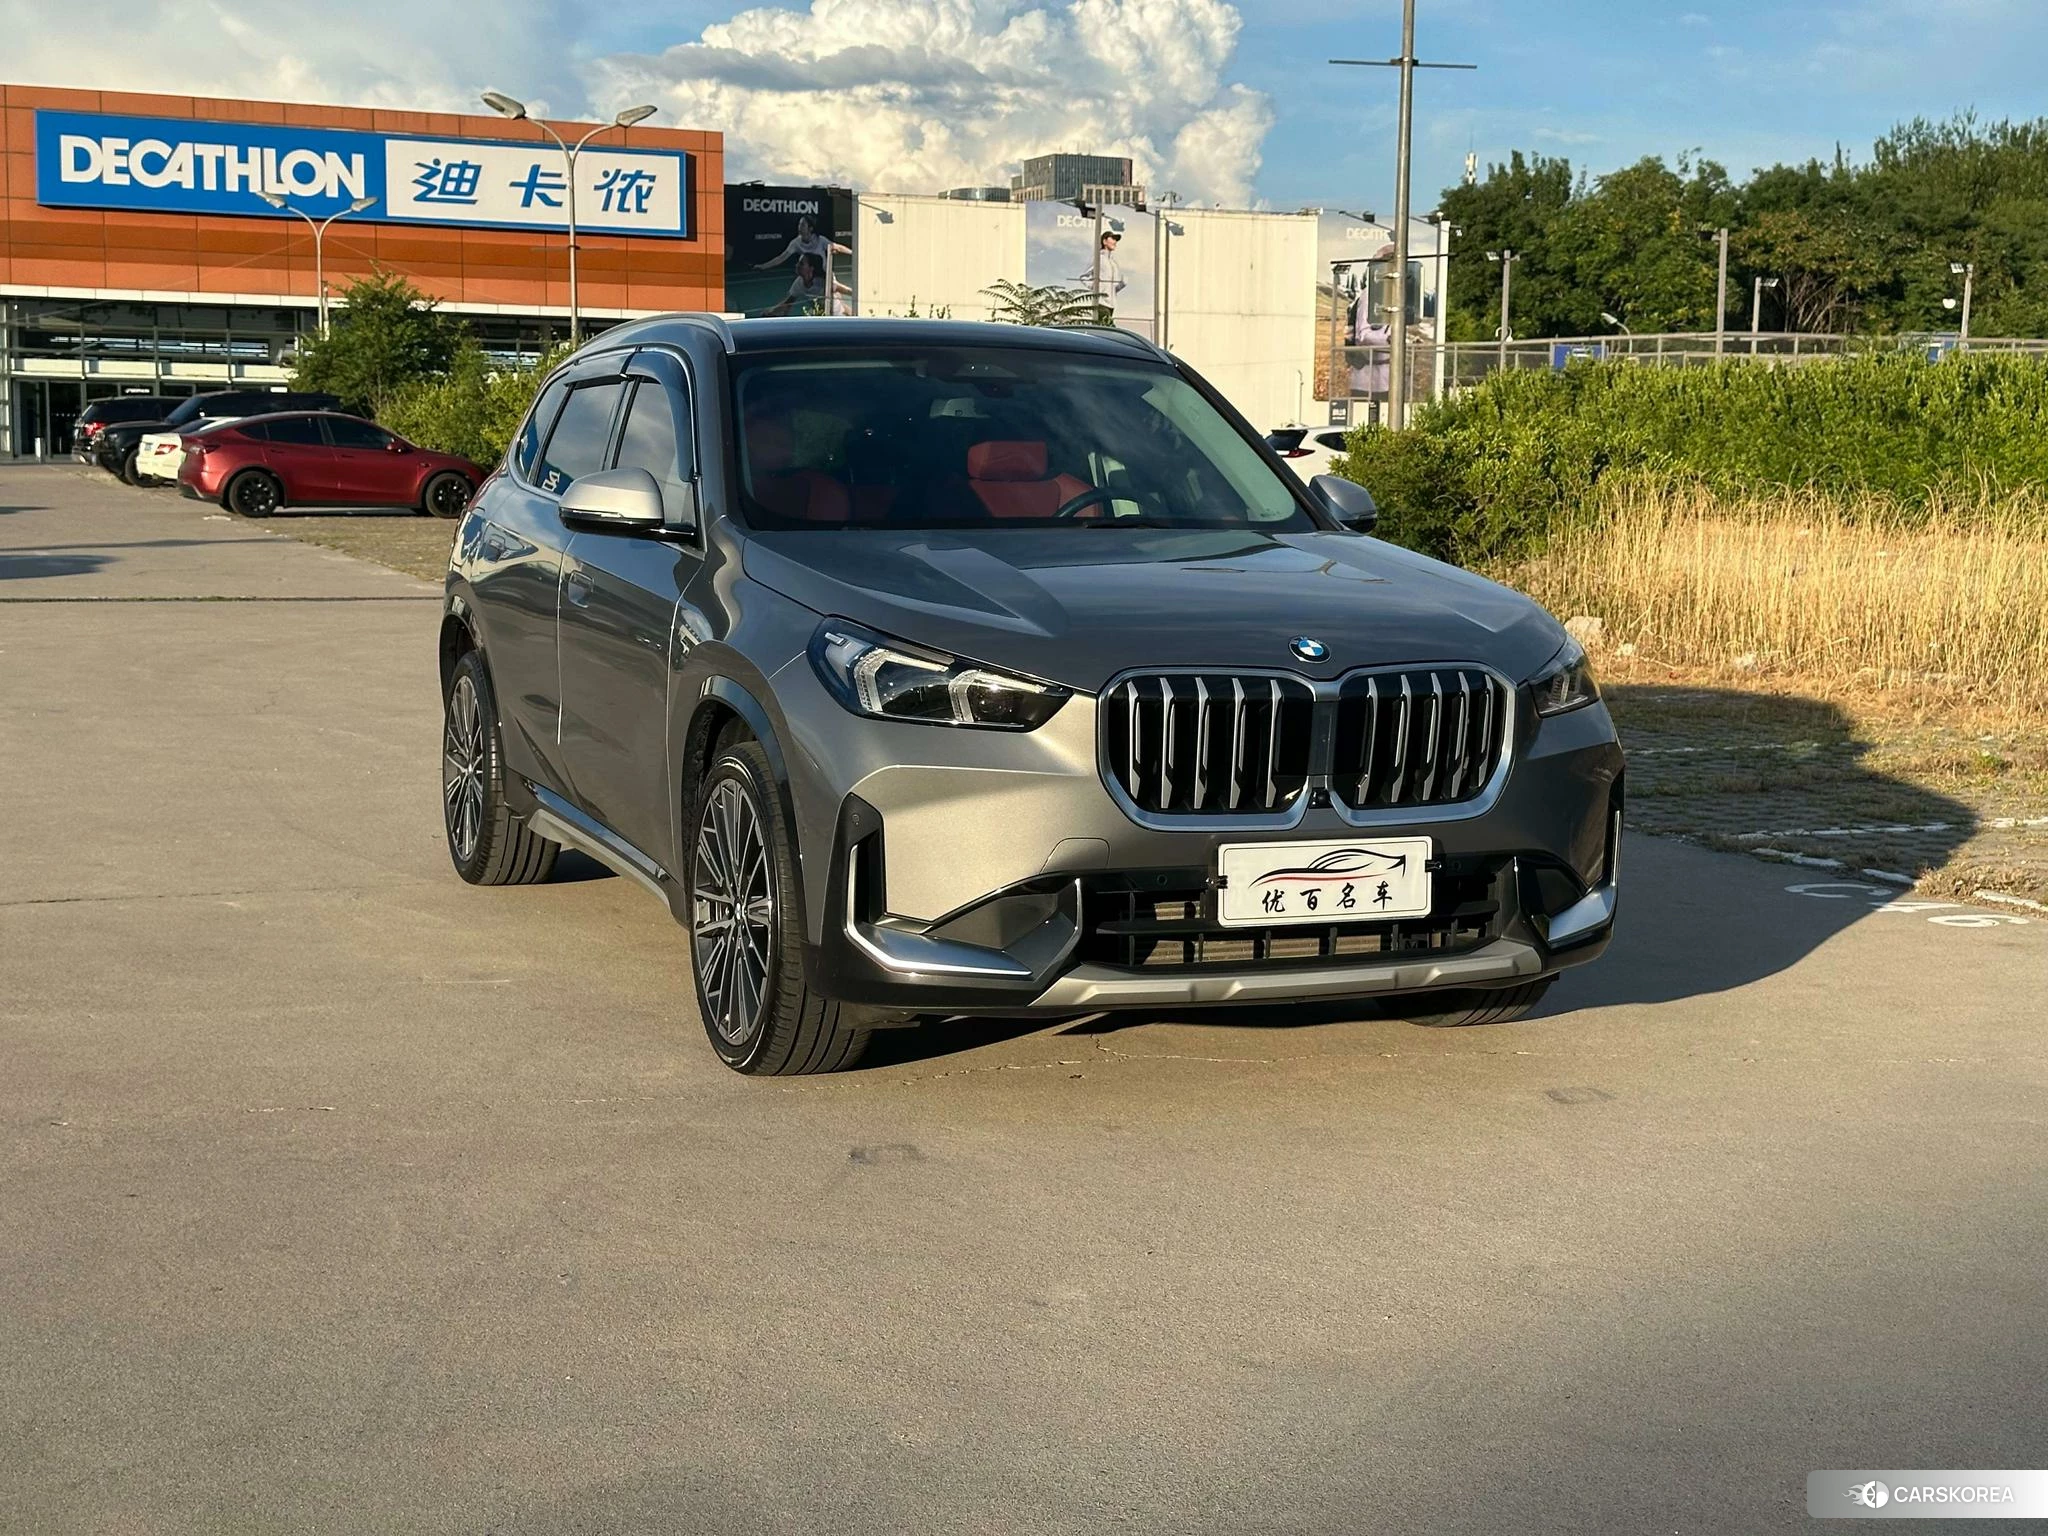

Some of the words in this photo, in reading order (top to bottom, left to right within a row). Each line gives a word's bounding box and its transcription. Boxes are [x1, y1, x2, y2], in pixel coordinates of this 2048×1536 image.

[60, 134, 366, 199] DECATHLON
[411, 156, 657, 214] 迪卡侬
[743, 198, 819, 215] DECATHLON
[1261, 879, 1393, 914] 优百名车
